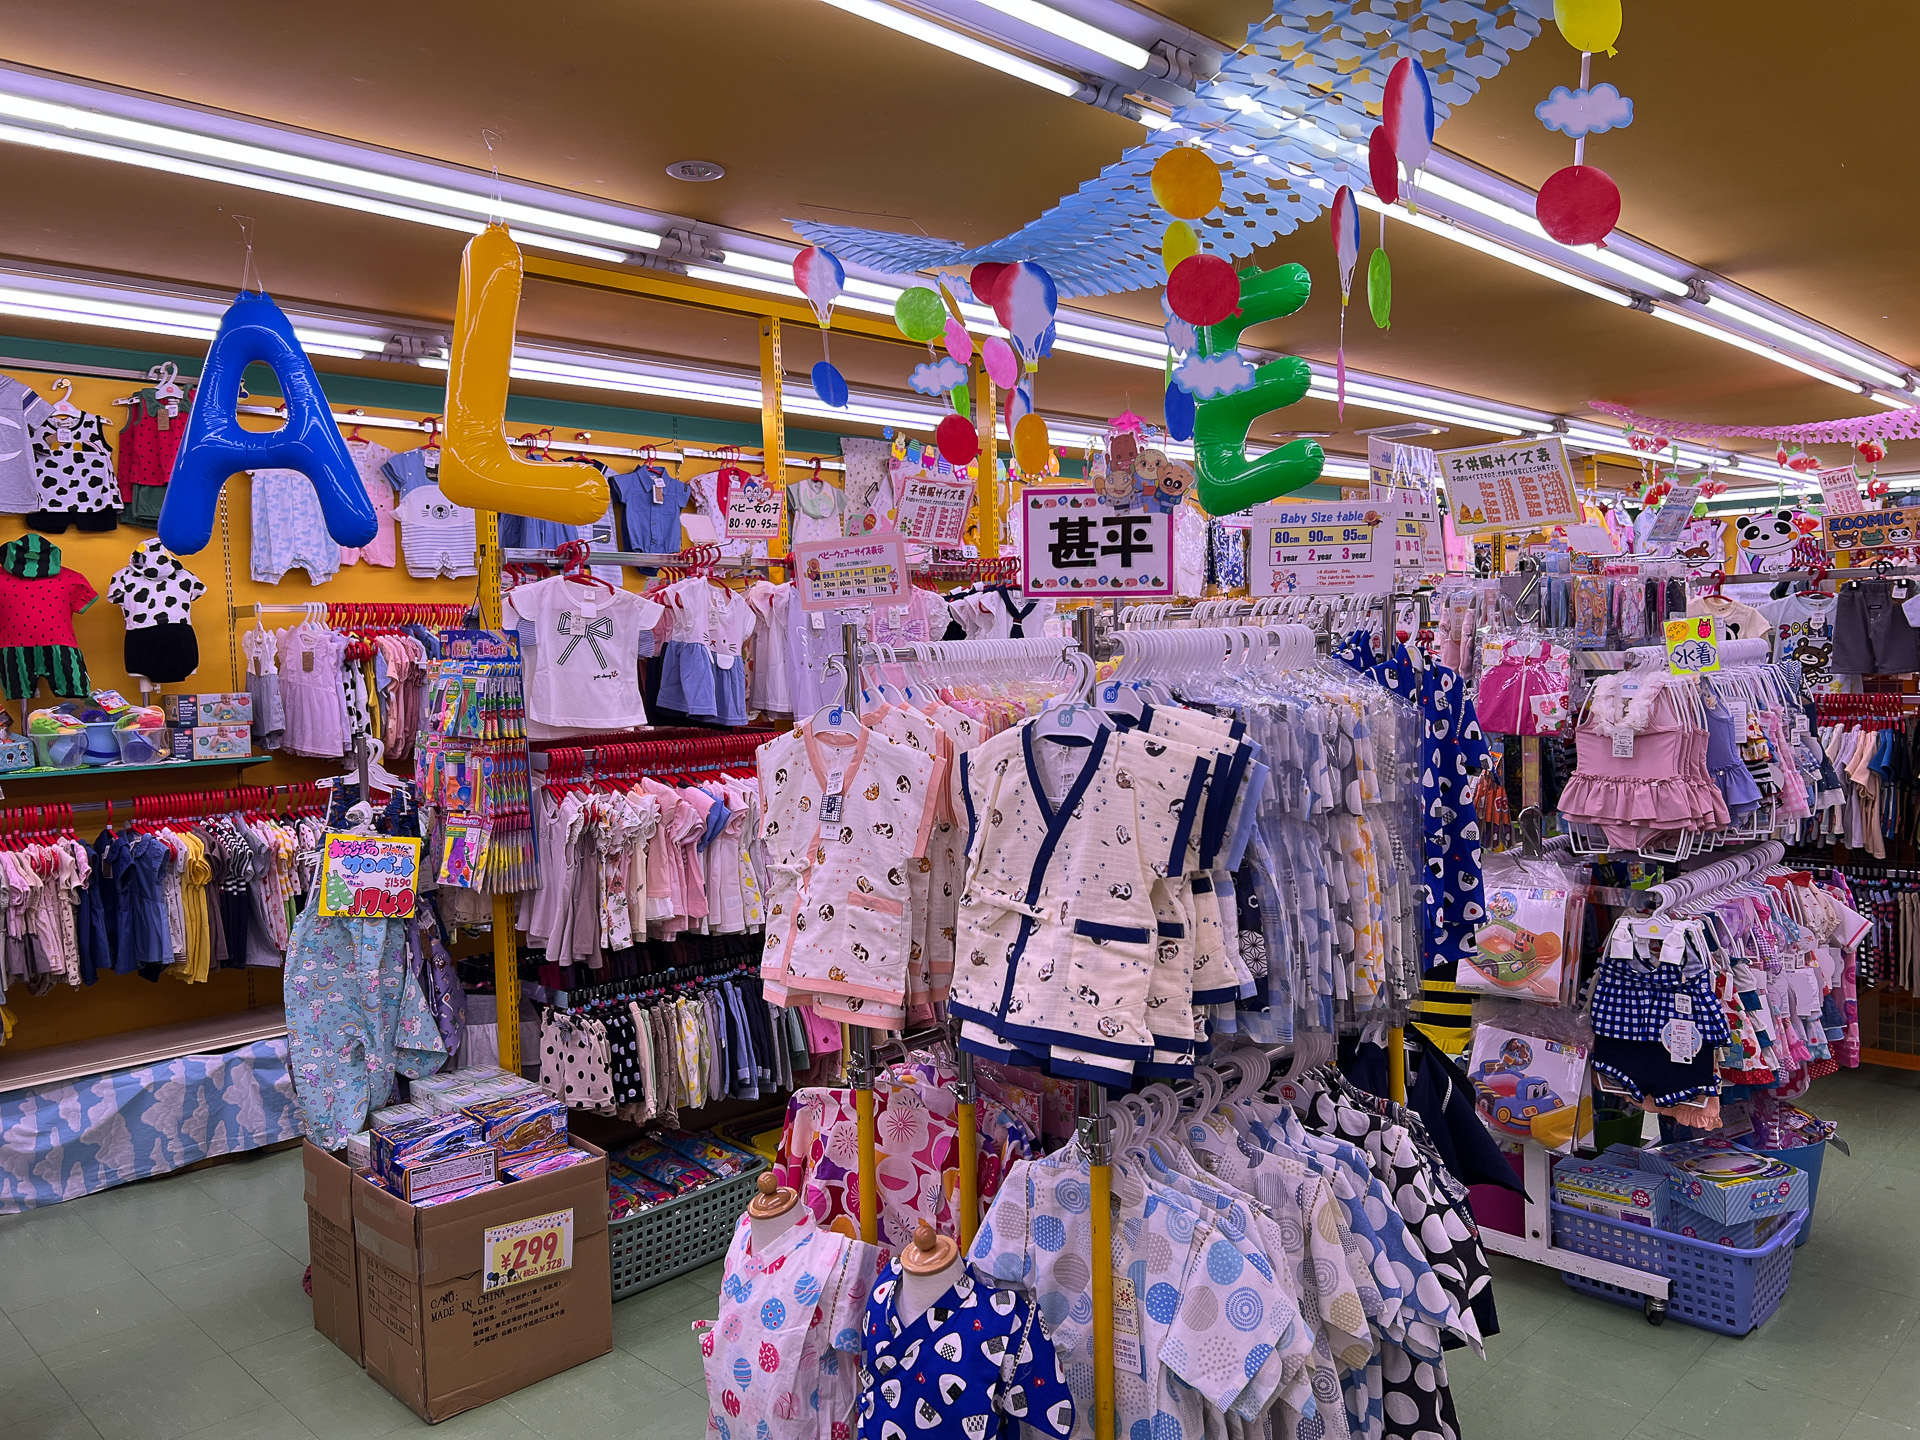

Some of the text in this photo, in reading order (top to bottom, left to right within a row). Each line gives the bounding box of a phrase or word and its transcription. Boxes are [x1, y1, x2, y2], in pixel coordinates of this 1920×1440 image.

[1452, 447, 1551, 474] 子供服サイズ表
[910, 484, 966, 501] 子供服サイズ表
[729, 503, 780, 514] ベビー女の子
[1280, 511, 1363, 524] Baby Size table
[1829, 511, 1904, 532] ZOOMIC
[1048, 515, 1154, 569] 甚平
[1275, 529, 1368, 544] 80cm 90cm 95cm
[1275, 547, 1366, 563] 1 year 2 year 3 year
[1676, 643, 1711, 664] 水着
[1106, 690, 1115, 700] 80
[1060, 714, 1070, 724] 80
[342, 855, 415, 877] サロペット
[385, 877, 411, 888] ¥1590
[1282, 1089, 1294, 1097] 110
[1191, 1131, 1204, 1140] 120
[501, 1232, 558, 1270] ¥299
[431, 1289, 506, 1322] MADE IN CHINA
